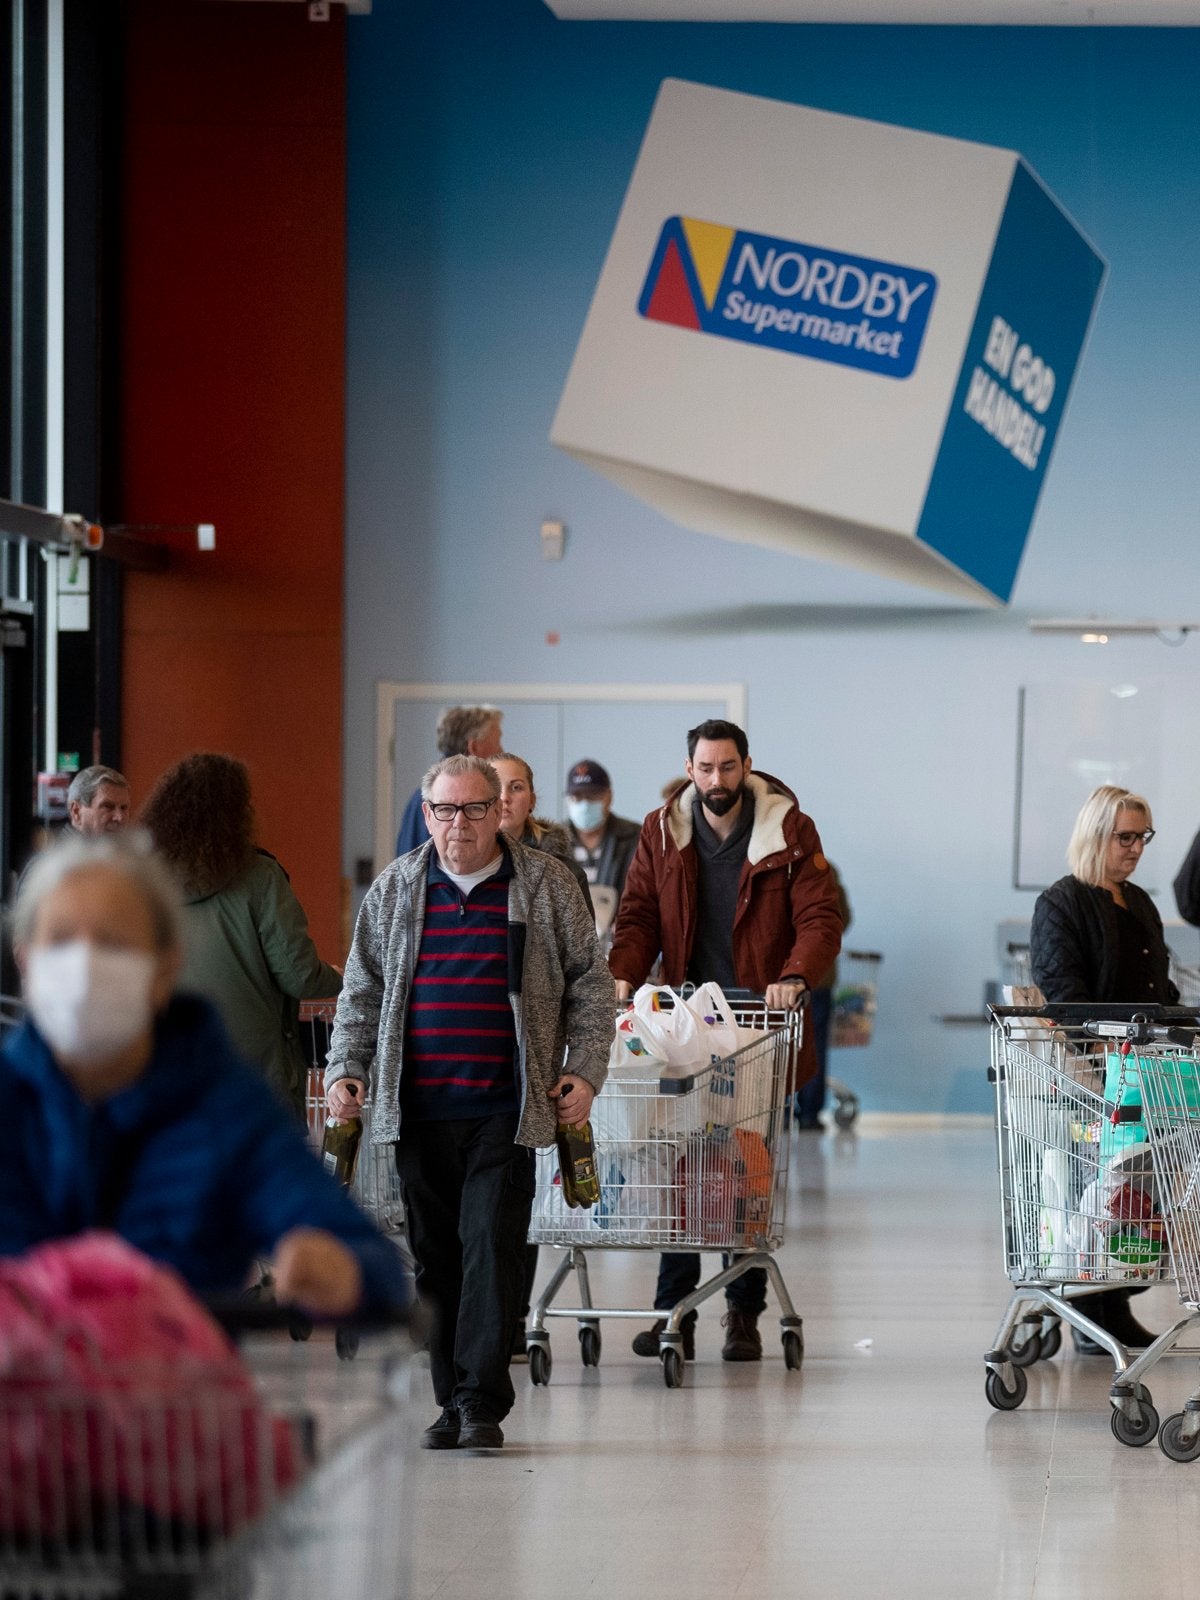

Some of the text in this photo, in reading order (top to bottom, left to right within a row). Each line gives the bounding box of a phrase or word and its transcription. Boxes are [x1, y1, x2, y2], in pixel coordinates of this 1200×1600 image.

[732, 243, 927, 323] NORDBY
[723, 292, 903, 357] Supermarket
[983, 315, 1056, 414] EN GOD
